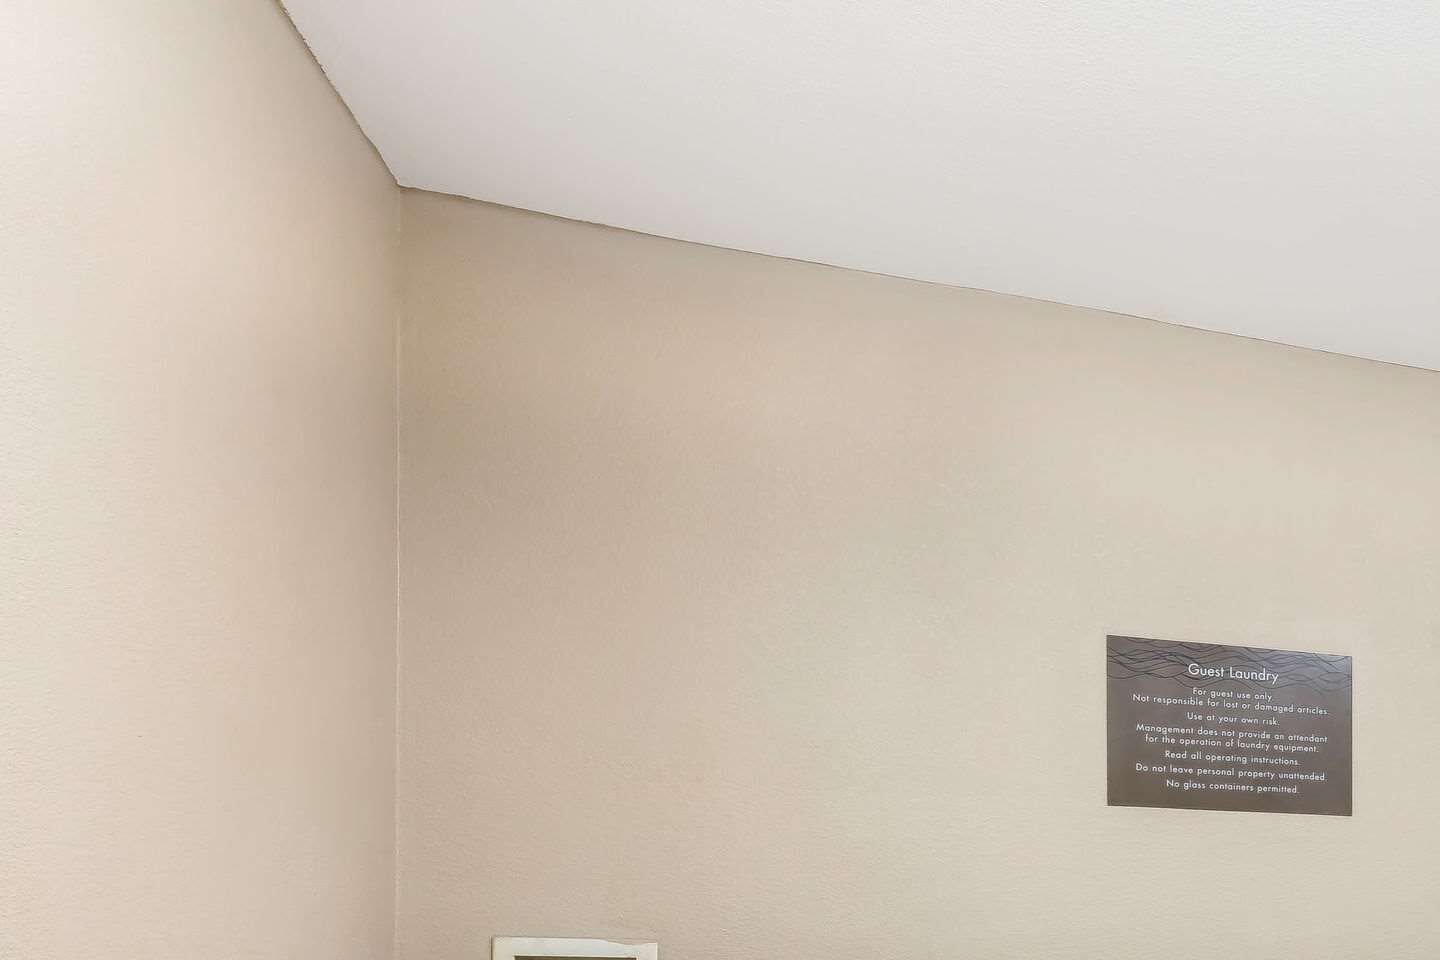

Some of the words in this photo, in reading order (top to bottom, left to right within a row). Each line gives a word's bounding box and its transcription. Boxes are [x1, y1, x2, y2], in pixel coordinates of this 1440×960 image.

[1188, 663, 1225, 678] Guest
[1230, 667, 1279, 684] Laundry
[1192, 687, 1207, 696] For
[1211, 690, 1233, 699] guest
[1133, 694, 1150, 702] Not
[1153, 695, 1203, 706] responsible
[1207, 699, 1220, 707] for
[1223, 700, 1238, 709] lost
[1254, 703, 1293, 714] damaged
[1187, 712, 1203, 721] Use
[1218, 715, 1238, 724] your
[1241, 717, 1259, 725] own
[1136, 724, 1194, 735] Management
[1198, 727, 1218, 736] does
[1221, 729, 1235, 737] not
[1238, 730, 1271, 740] provide
[1288, 733, 1328, 743] attendant
[1145, 735, 1158, 743] for
[1162, 736, 1176, 744] the
[1179, 737, 1222, 748] operation
[1225, 739, 1234, 747] of
[1237, 739, 1269, 751] laundry
[1165, 750, 1187, 759] Read
[1191, 752, 1202, 760] all
[1205, 753, 1247, 765] operating
[1135, 763, 1149, 772] Do
[1152, 764, 1166, 773] not
[1170, 765, 1193, 774] leave
[1197, 767, 1234, 777] personal
[1238, 769, 1276, 780] property
[1166, 779, 1180, 788] No
[1184, 781, 1206, 792] glass
[1209, 782, 1254, 792] containers
